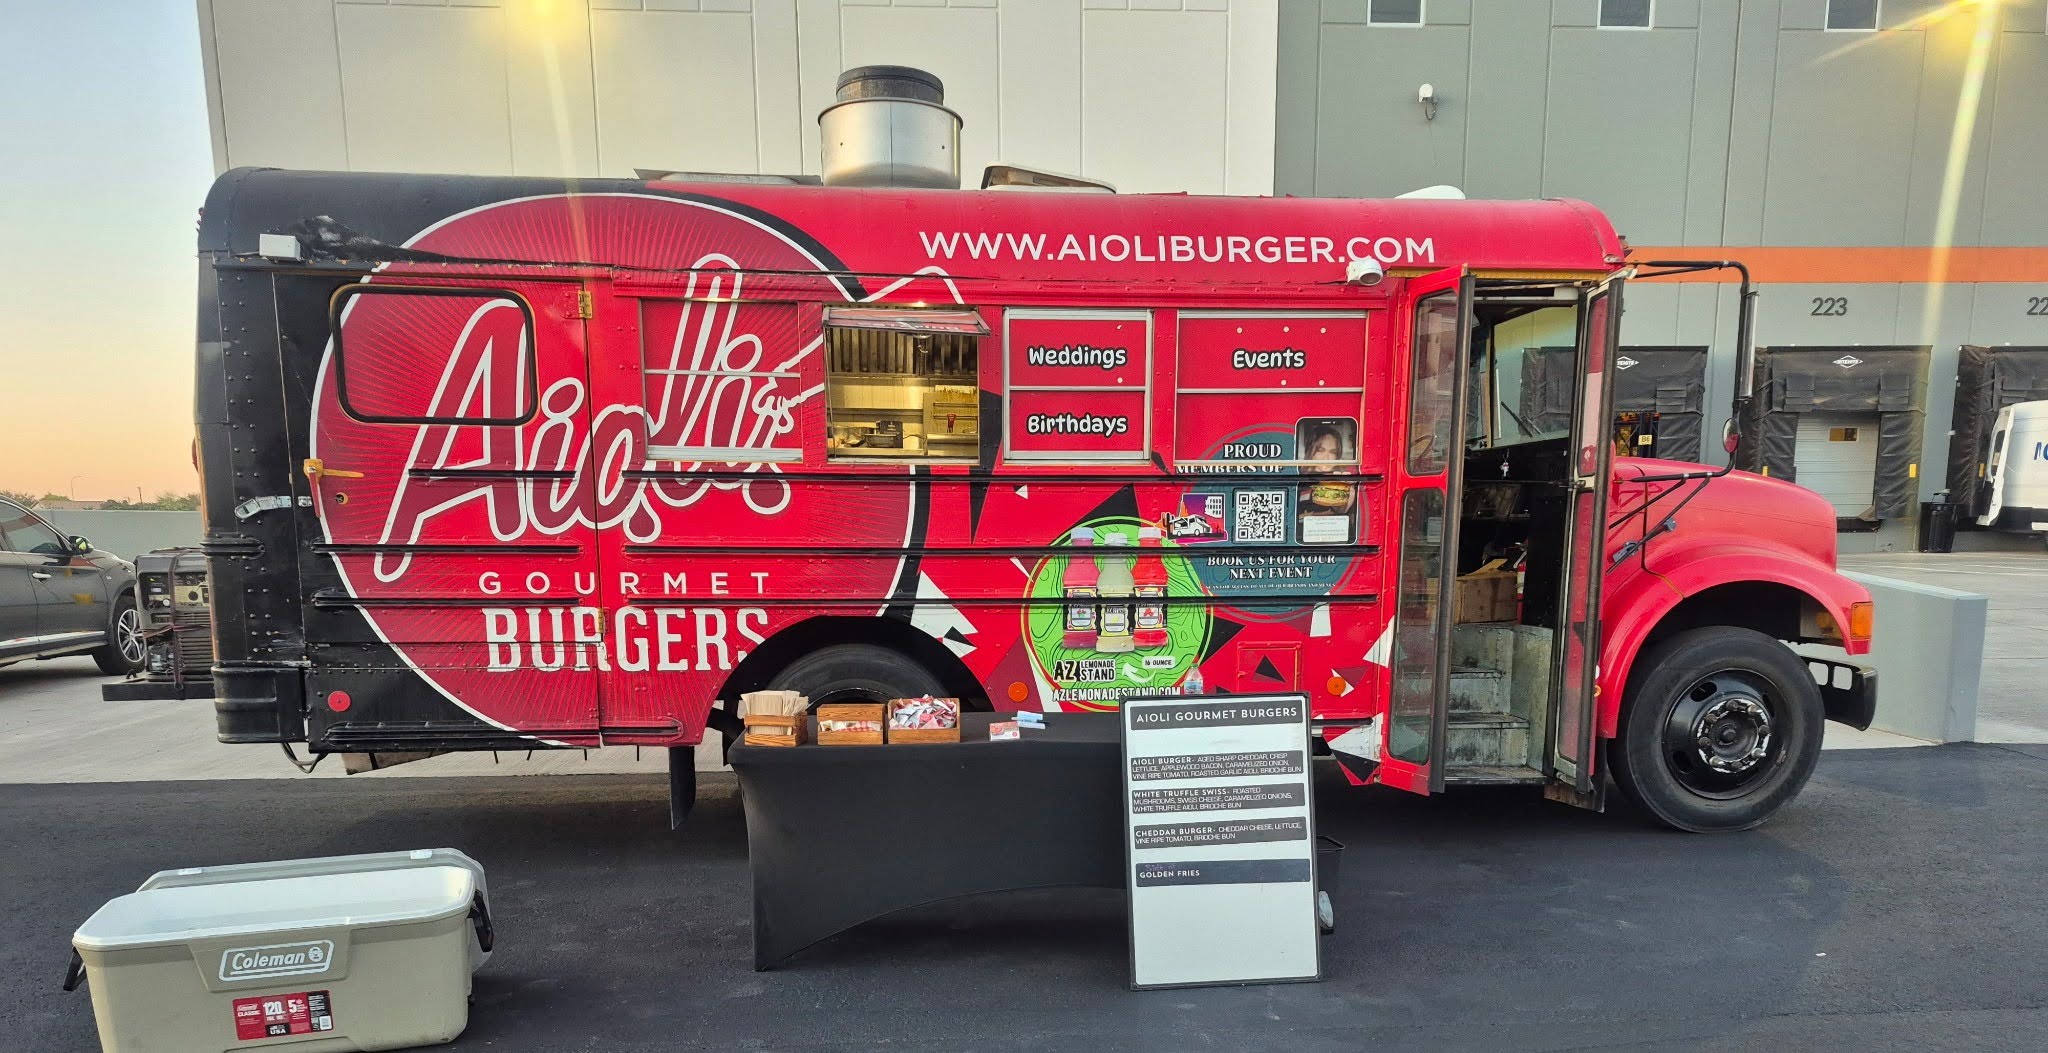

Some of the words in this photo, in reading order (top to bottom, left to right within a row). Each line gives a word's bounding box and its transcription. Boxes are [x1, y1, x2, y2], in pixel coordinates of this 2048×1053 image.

[919, 231, 1434, 264] WWW.AIOLIBURGER.COM
[1811, 297, 1848, 316] 223
[1028, 346, 1127, 370] Weddings
[1232, 348, 1305, 370] Events
[374, 253, 792, 582] Aioli
[1027, 413, 1127, 438] Birthdays
[1223, 444, 1281, 458] PROUD
[1207, 556, 1244, 566] BOOK
[1248, 556, 1265, 565] US
[1269, 556, 1296, 565] FOR
[1300, 555, 1336, 564] YOUR
[1229, 568, 1265, 579] NEXT
[1268, 567, 1313, 578] EVENT
[479, 571, 769, 595] GOURMET
[483, 605, 769, 673] BURGERS
[1054, 660, 1077, 681] AZ
[1081, 660, 1114, 668] LEMONADE
[1081, 669, 1115, 680] STAND
[1053, 686, 1180, 701] AZLEMONADESTANDCOM
[1137, 713, 1169, 722] AIOLI
[1176, 710, 1236, 721] GOURMET
[1242, 708, 1297, 718] BURGERS
[1158, 756, 1194, 764] BURGER-
[1161, 763, 1200, 771] APPLEWOOD
[1226, 760, 1267, 768] CARAMELIZED
[1163, 789, 1198, 797] TRUFFLE
[1200, 802, 1226, 810] BRIOCHE
[1136, 829, 1176, 837] CHEDDAR
[1179, 827, 1215, 835] BURGER-
[1194, 833, 1220, 841] BRIOCHE
[1140, 870, 1174, 878] GOLDEN
[232, 951, 306, 970] Coleman
[263, 1001, 283, 1016] 120
[288, 1000, 297, 1013] 5
